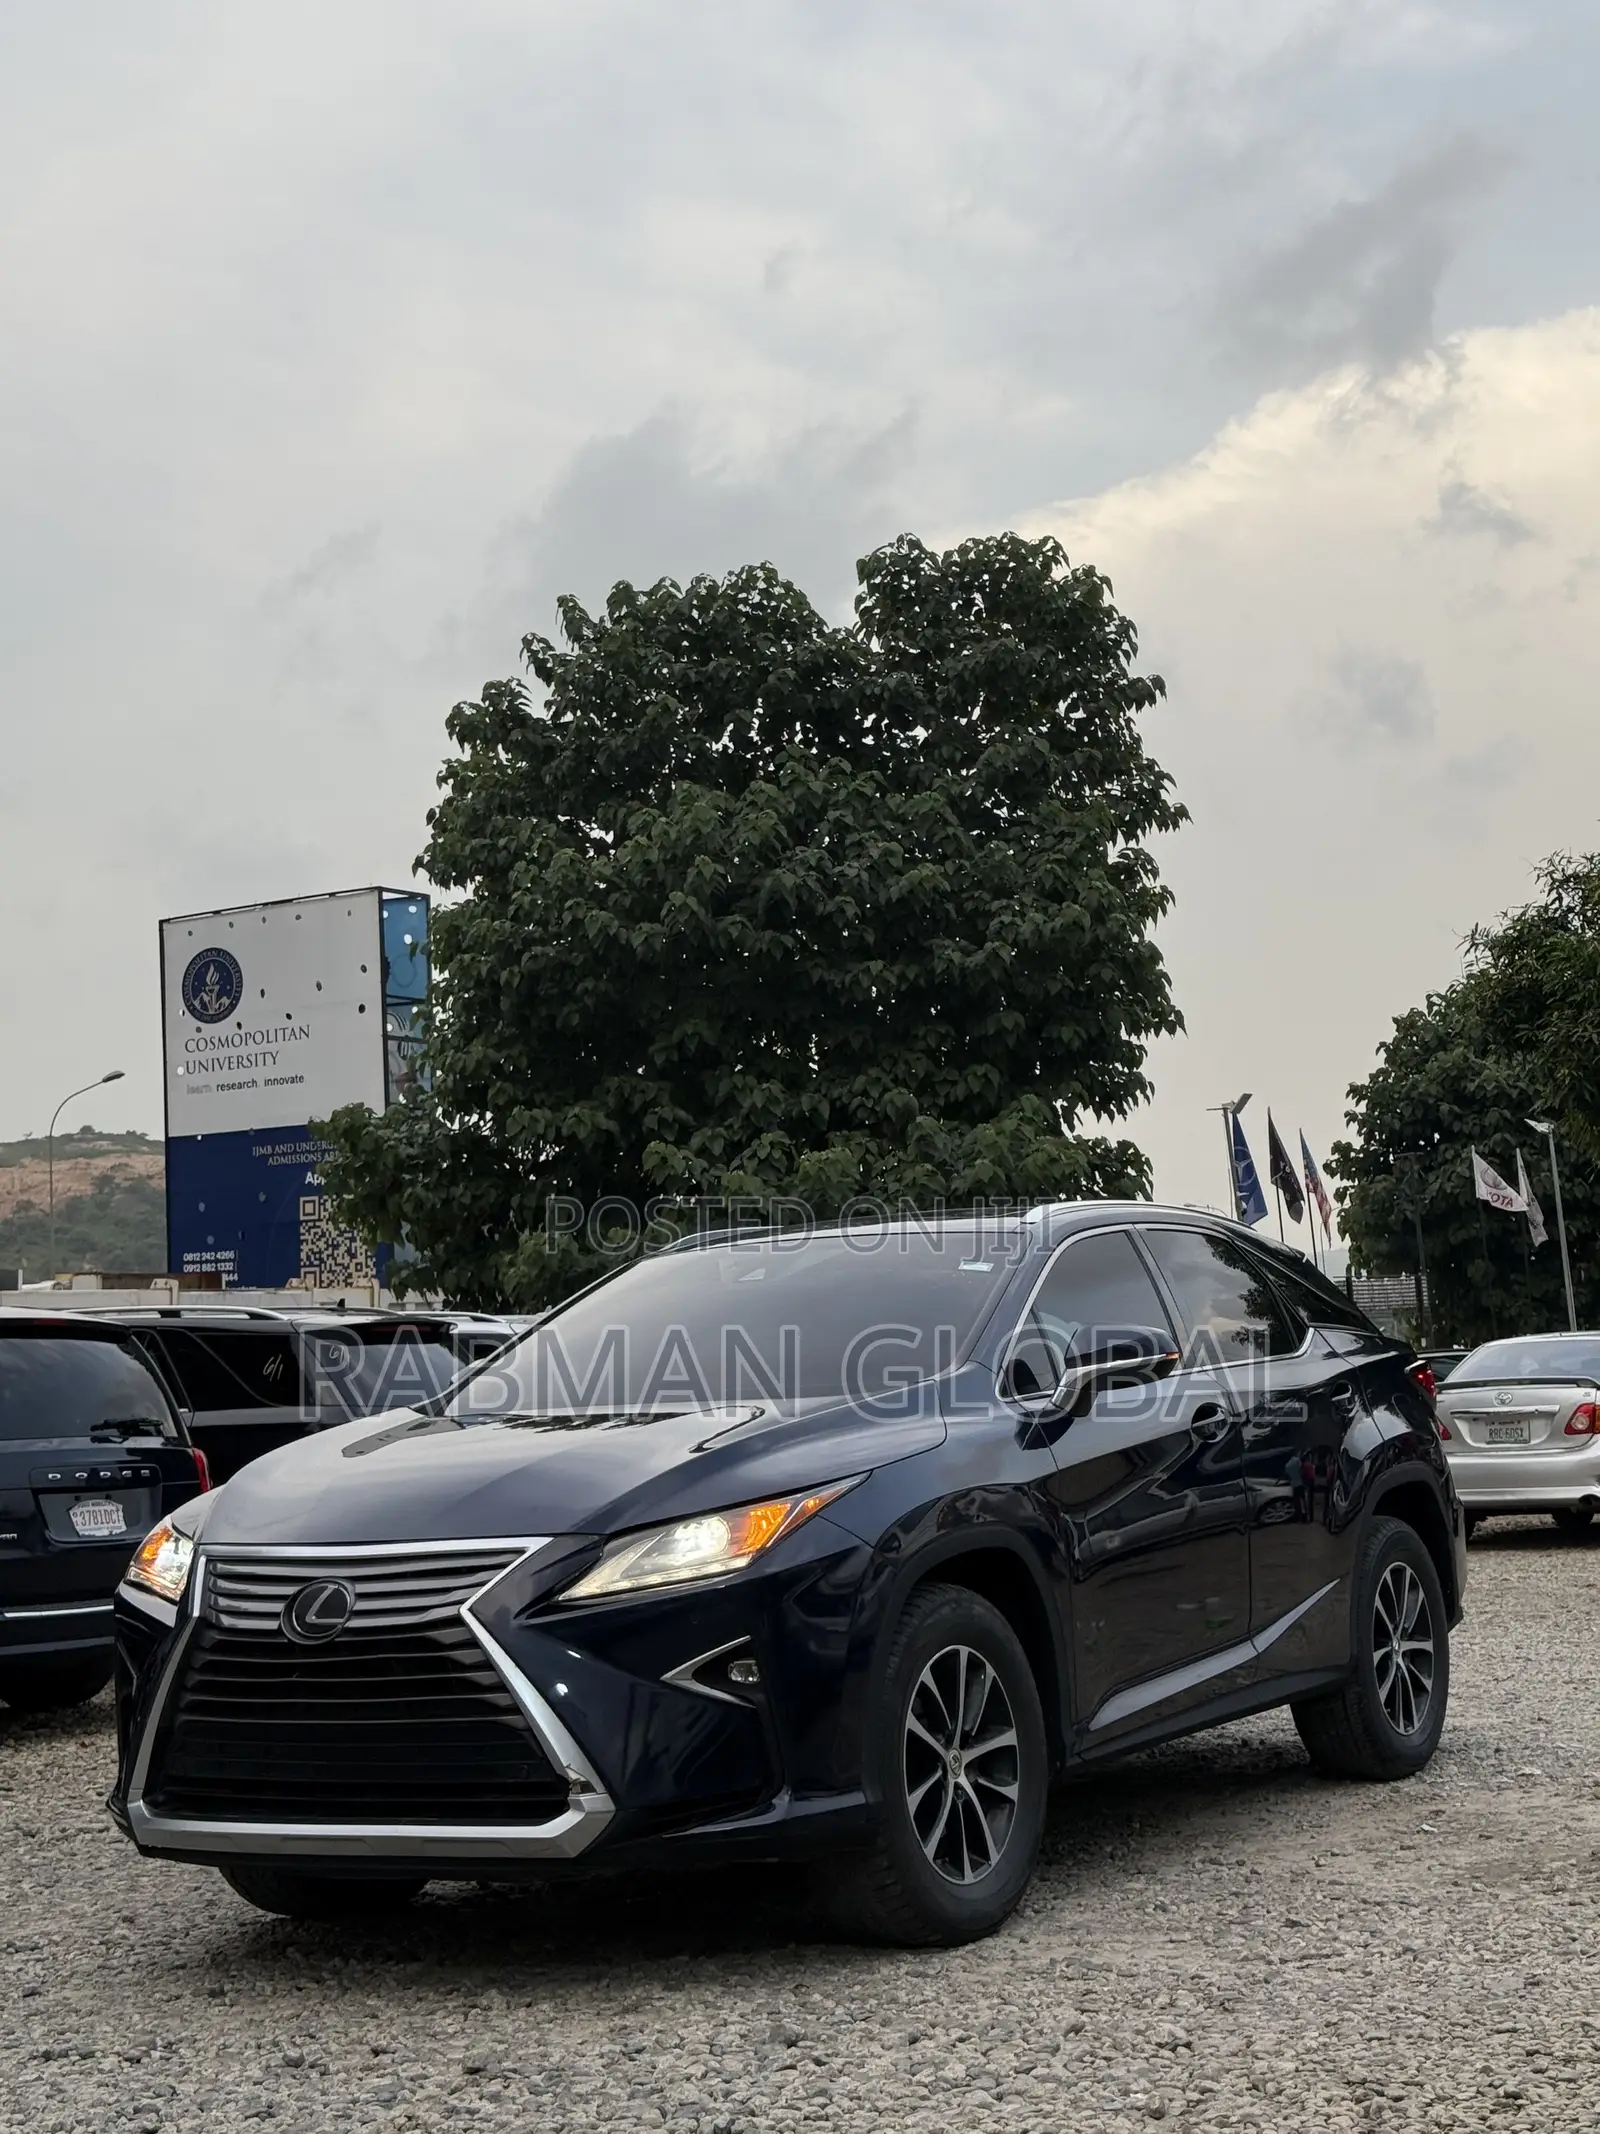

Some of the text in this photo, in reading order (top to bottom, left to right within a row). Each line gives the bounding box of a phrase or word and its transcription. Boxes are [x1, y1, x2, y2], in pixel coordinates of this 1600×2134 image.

[184, 1024, 311, 1053] COSMOPOLITAN
[185, 1050, 280, 1075] UNIVERSITY
[264, 1074, 305, 1087] innovate
[252, 1146, 273, 1158] IJMB
[274, 1143, 295, 1154] AND
[267, 1151, 322, 1166] ADMISSIONS
[183, 1253, 201, 1262] 0812
[201, 1252, 216, 1261] 242
[183, 1262, 234, 1273] 0912 882 1332
[48, 1469, 151, 1480] DODGE
